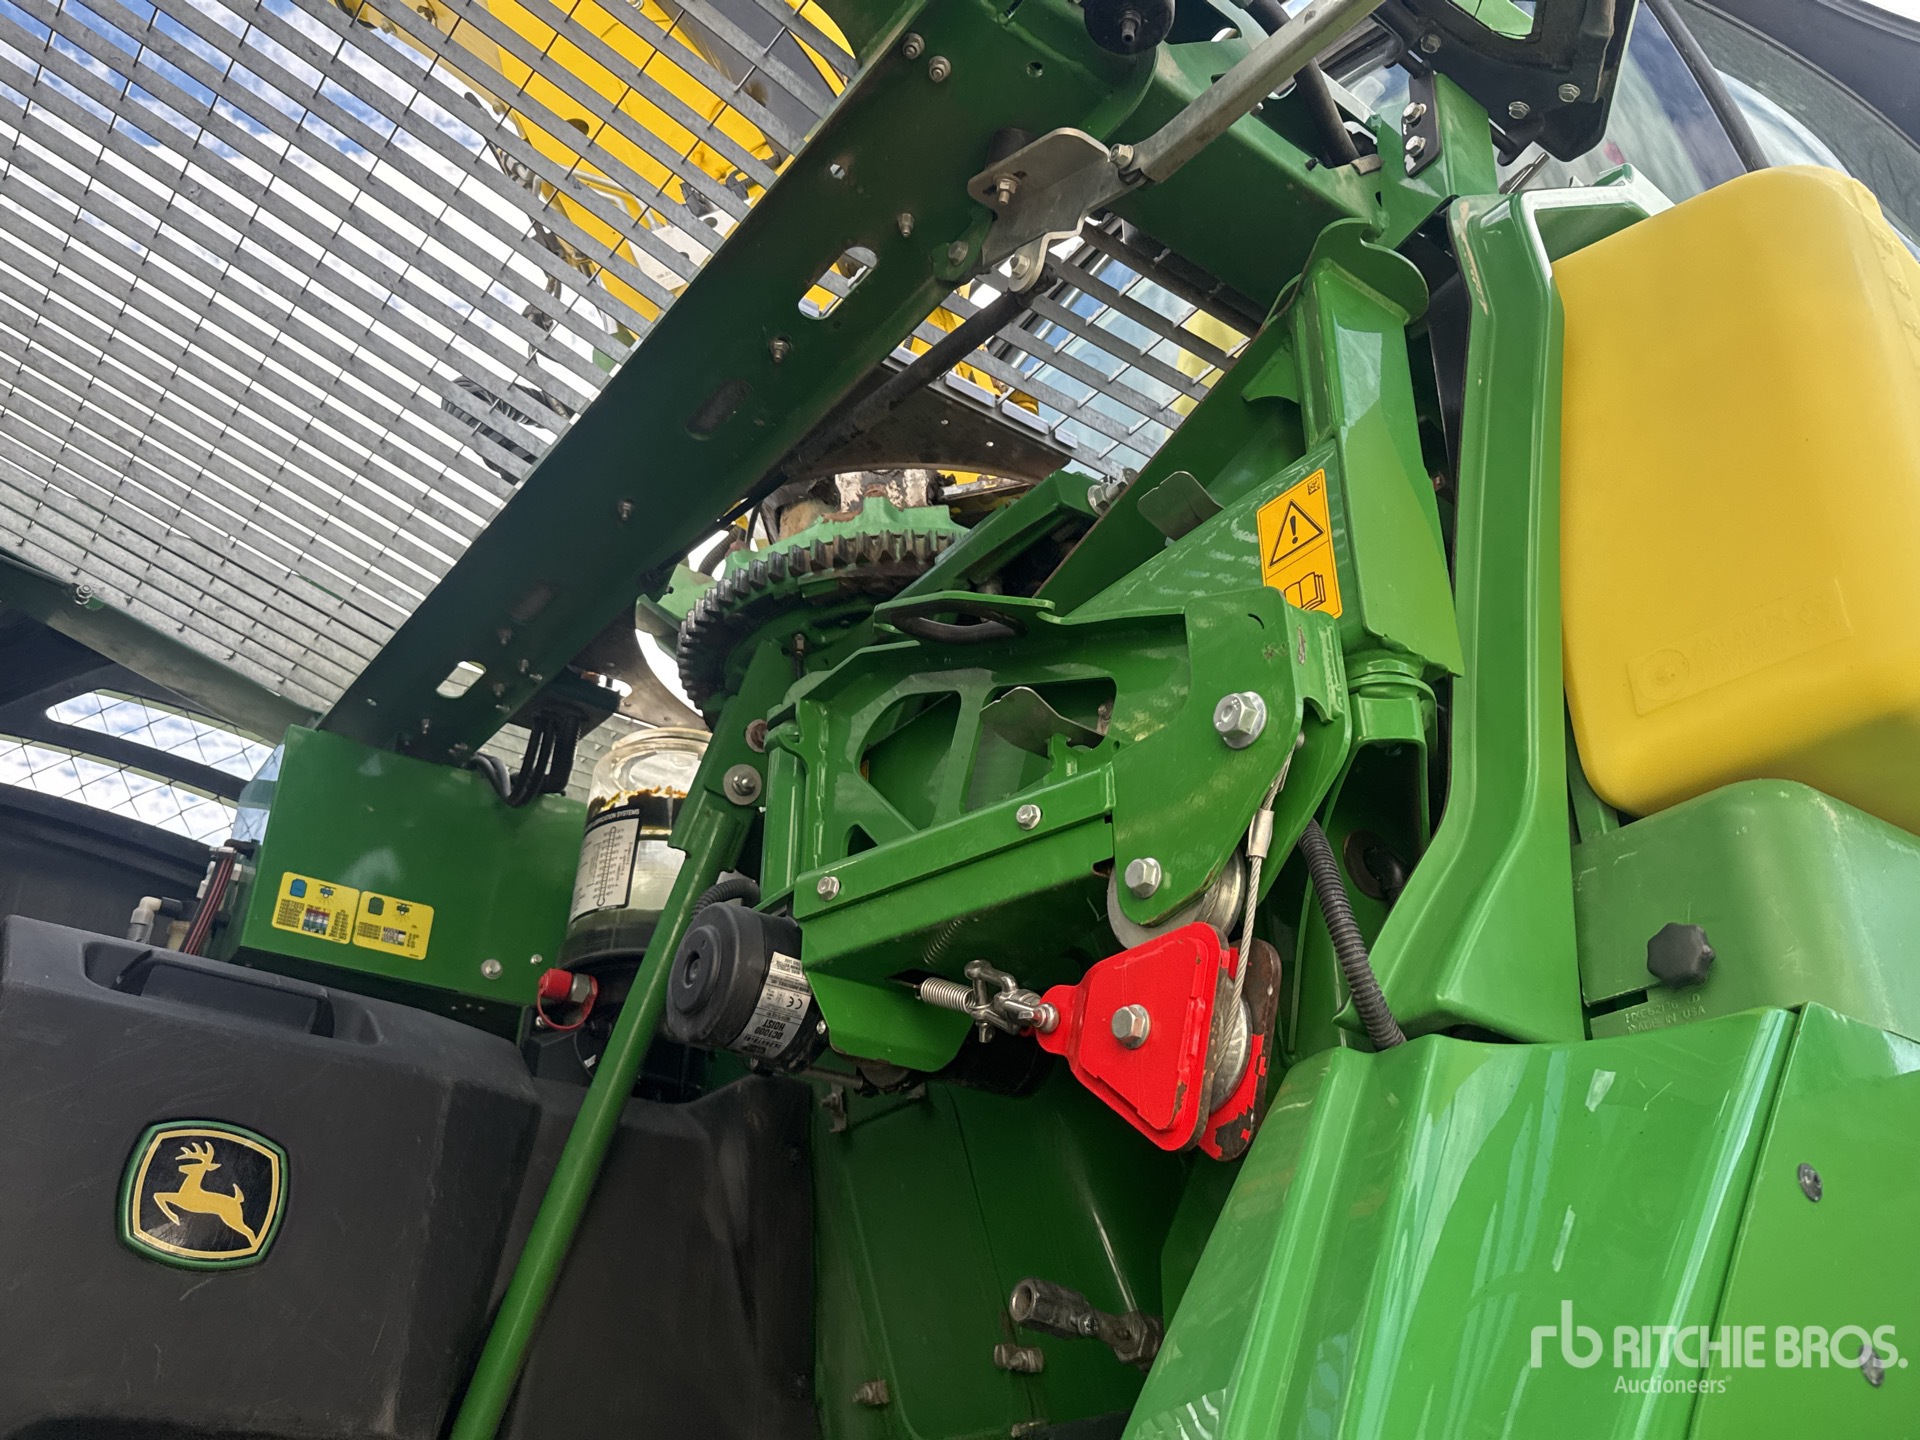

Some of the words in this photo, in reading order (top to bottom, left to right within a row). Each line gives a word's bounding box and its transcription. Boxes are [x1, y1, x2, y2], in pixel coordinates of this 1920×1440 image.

[1665, 1012, 1677, 1024] IN
[1682, 1005, 1706, 1019] USA
[762, 1018, 786, 1031] HOIST
[754, 1026, 784, 1039] DC1000
